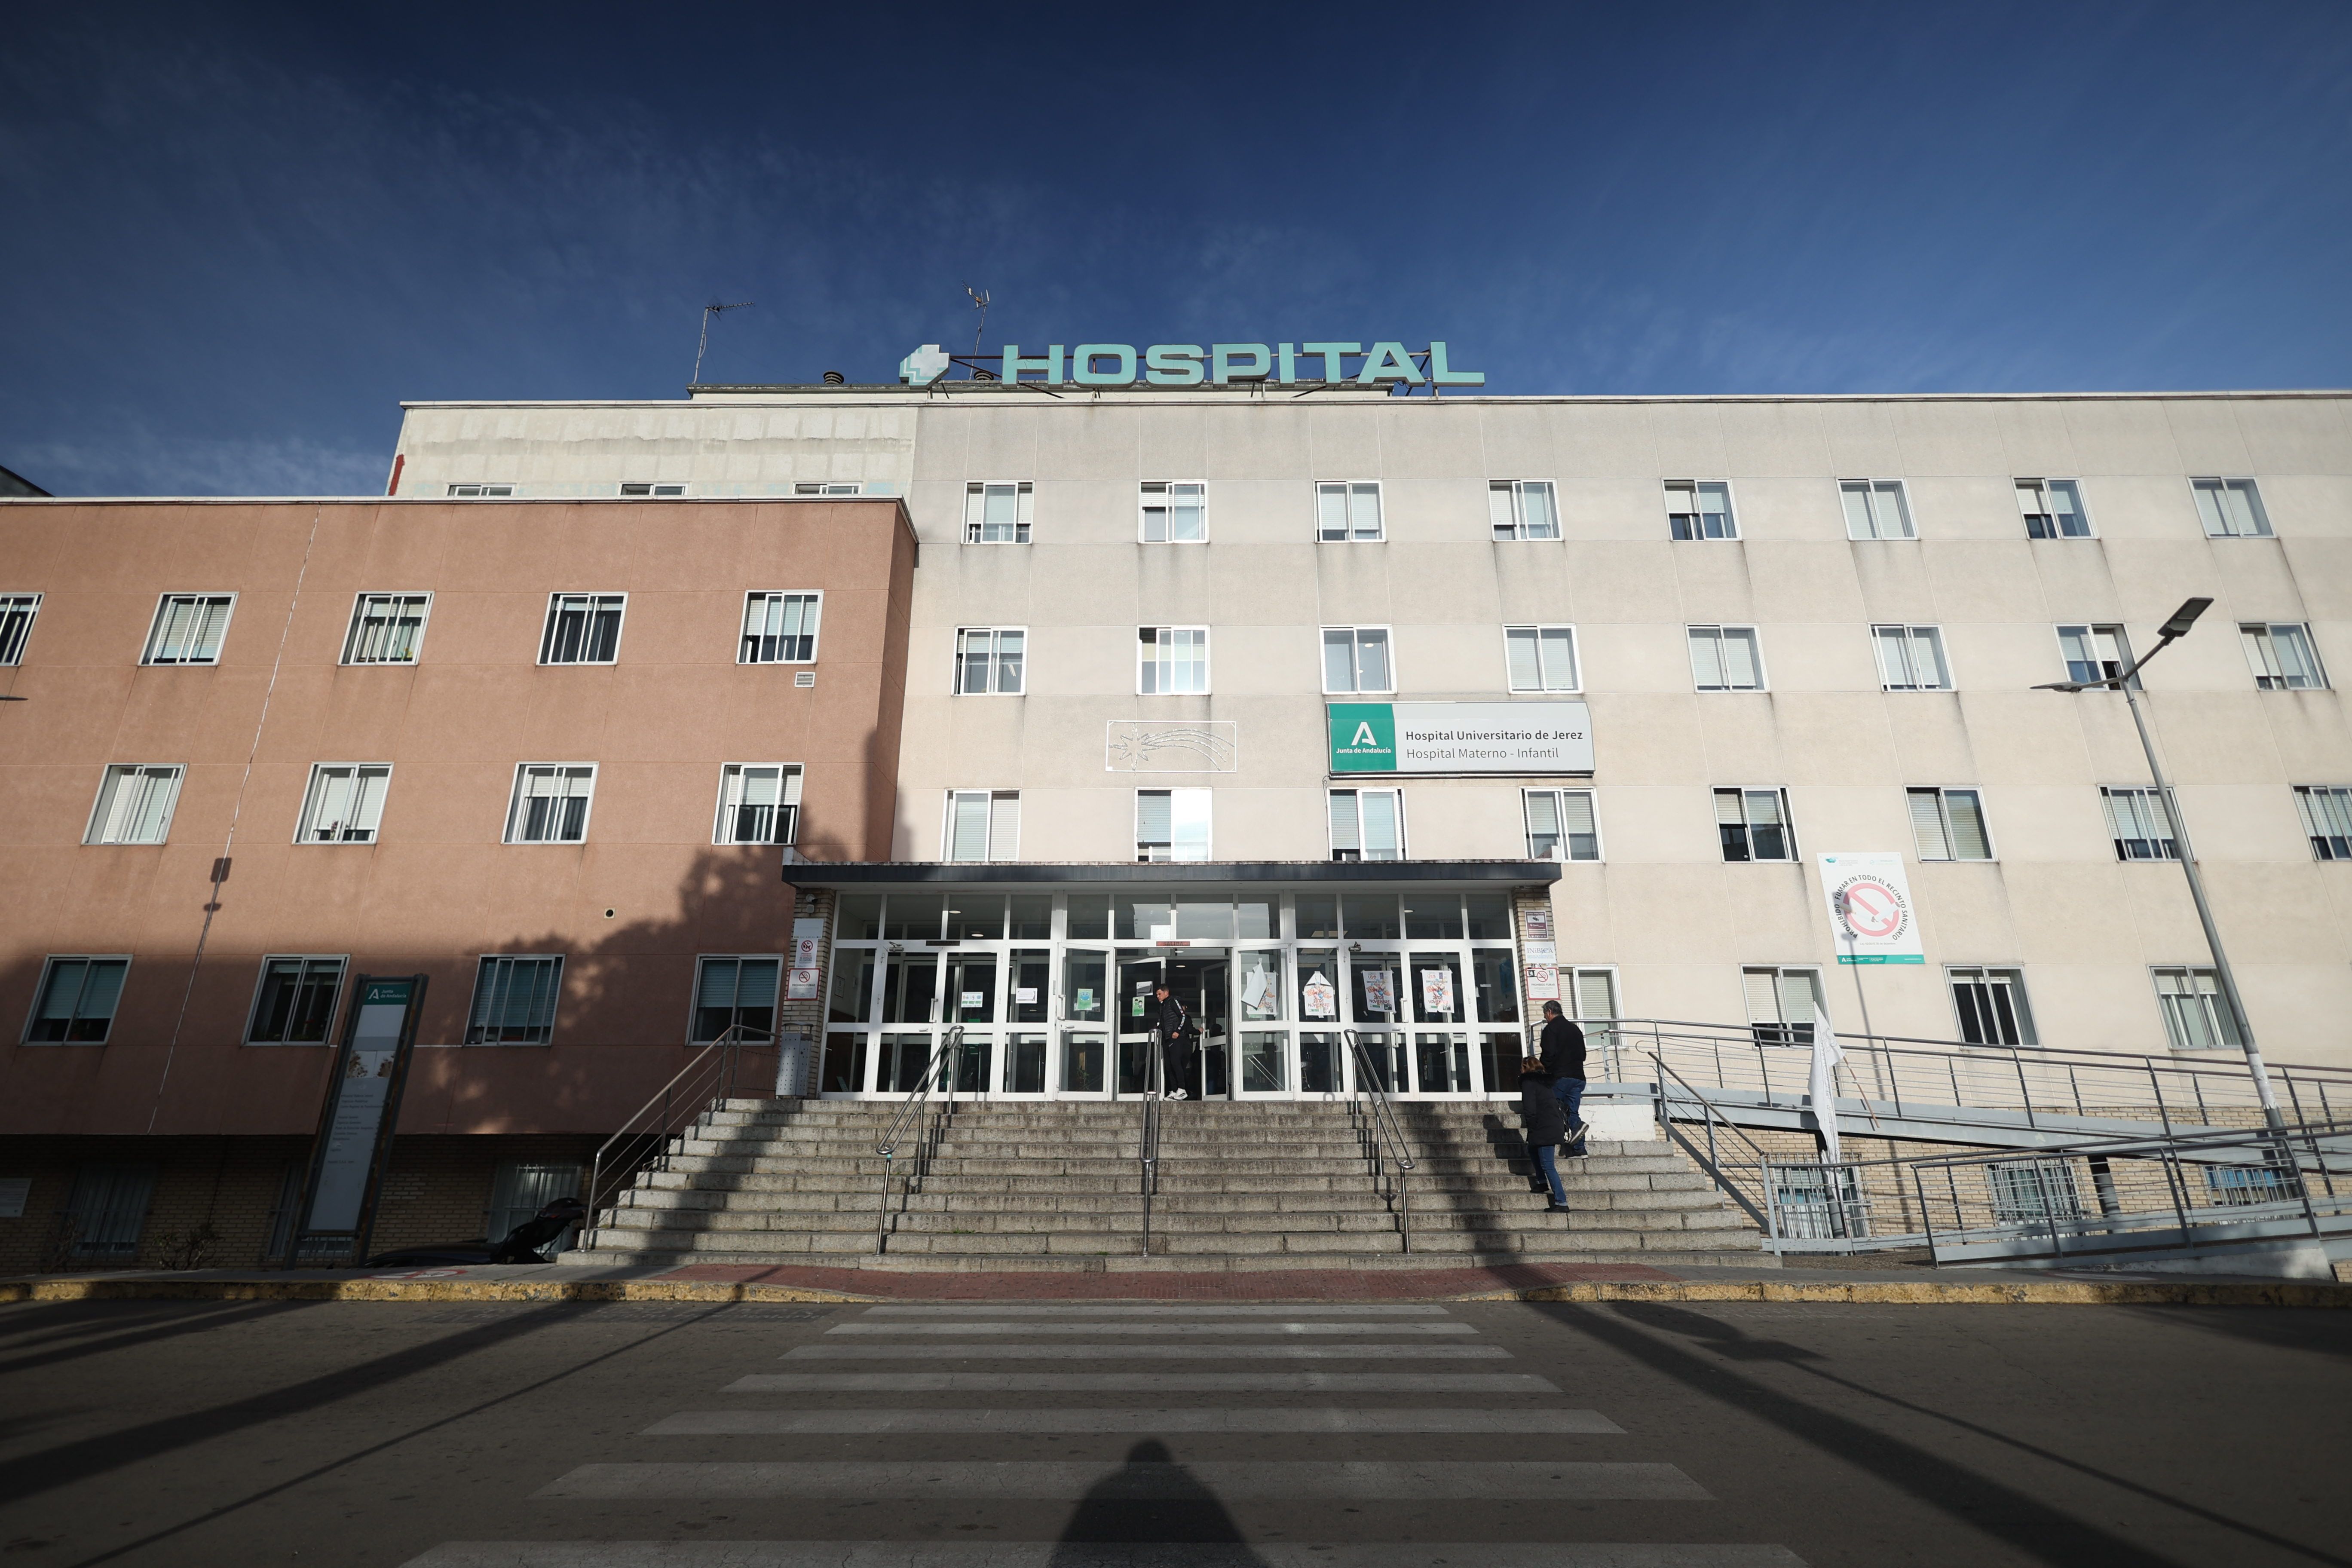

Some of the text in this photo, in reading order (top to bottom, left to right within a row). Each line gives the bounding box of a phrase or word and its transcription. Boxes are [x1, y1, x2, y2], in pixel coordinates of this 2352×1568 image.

[1002, 341, 1485, 389] HOSPITAL
[1406, 730, 1583, 742] Hospital Universitario de Jerez
[1407, 748, 1455, 761] Hospital
[1458, 748, 1507, 758] Materno
[1517, 747, 1559, 758] Infantil
[1834, 881, 1850, 900] FUMAR
[1886, 883, 1906, 908] RECINTO
[1834, 904, 1858, 938] PROHIBIDO
[1892, 910, 1908, 940] SANITARIO
